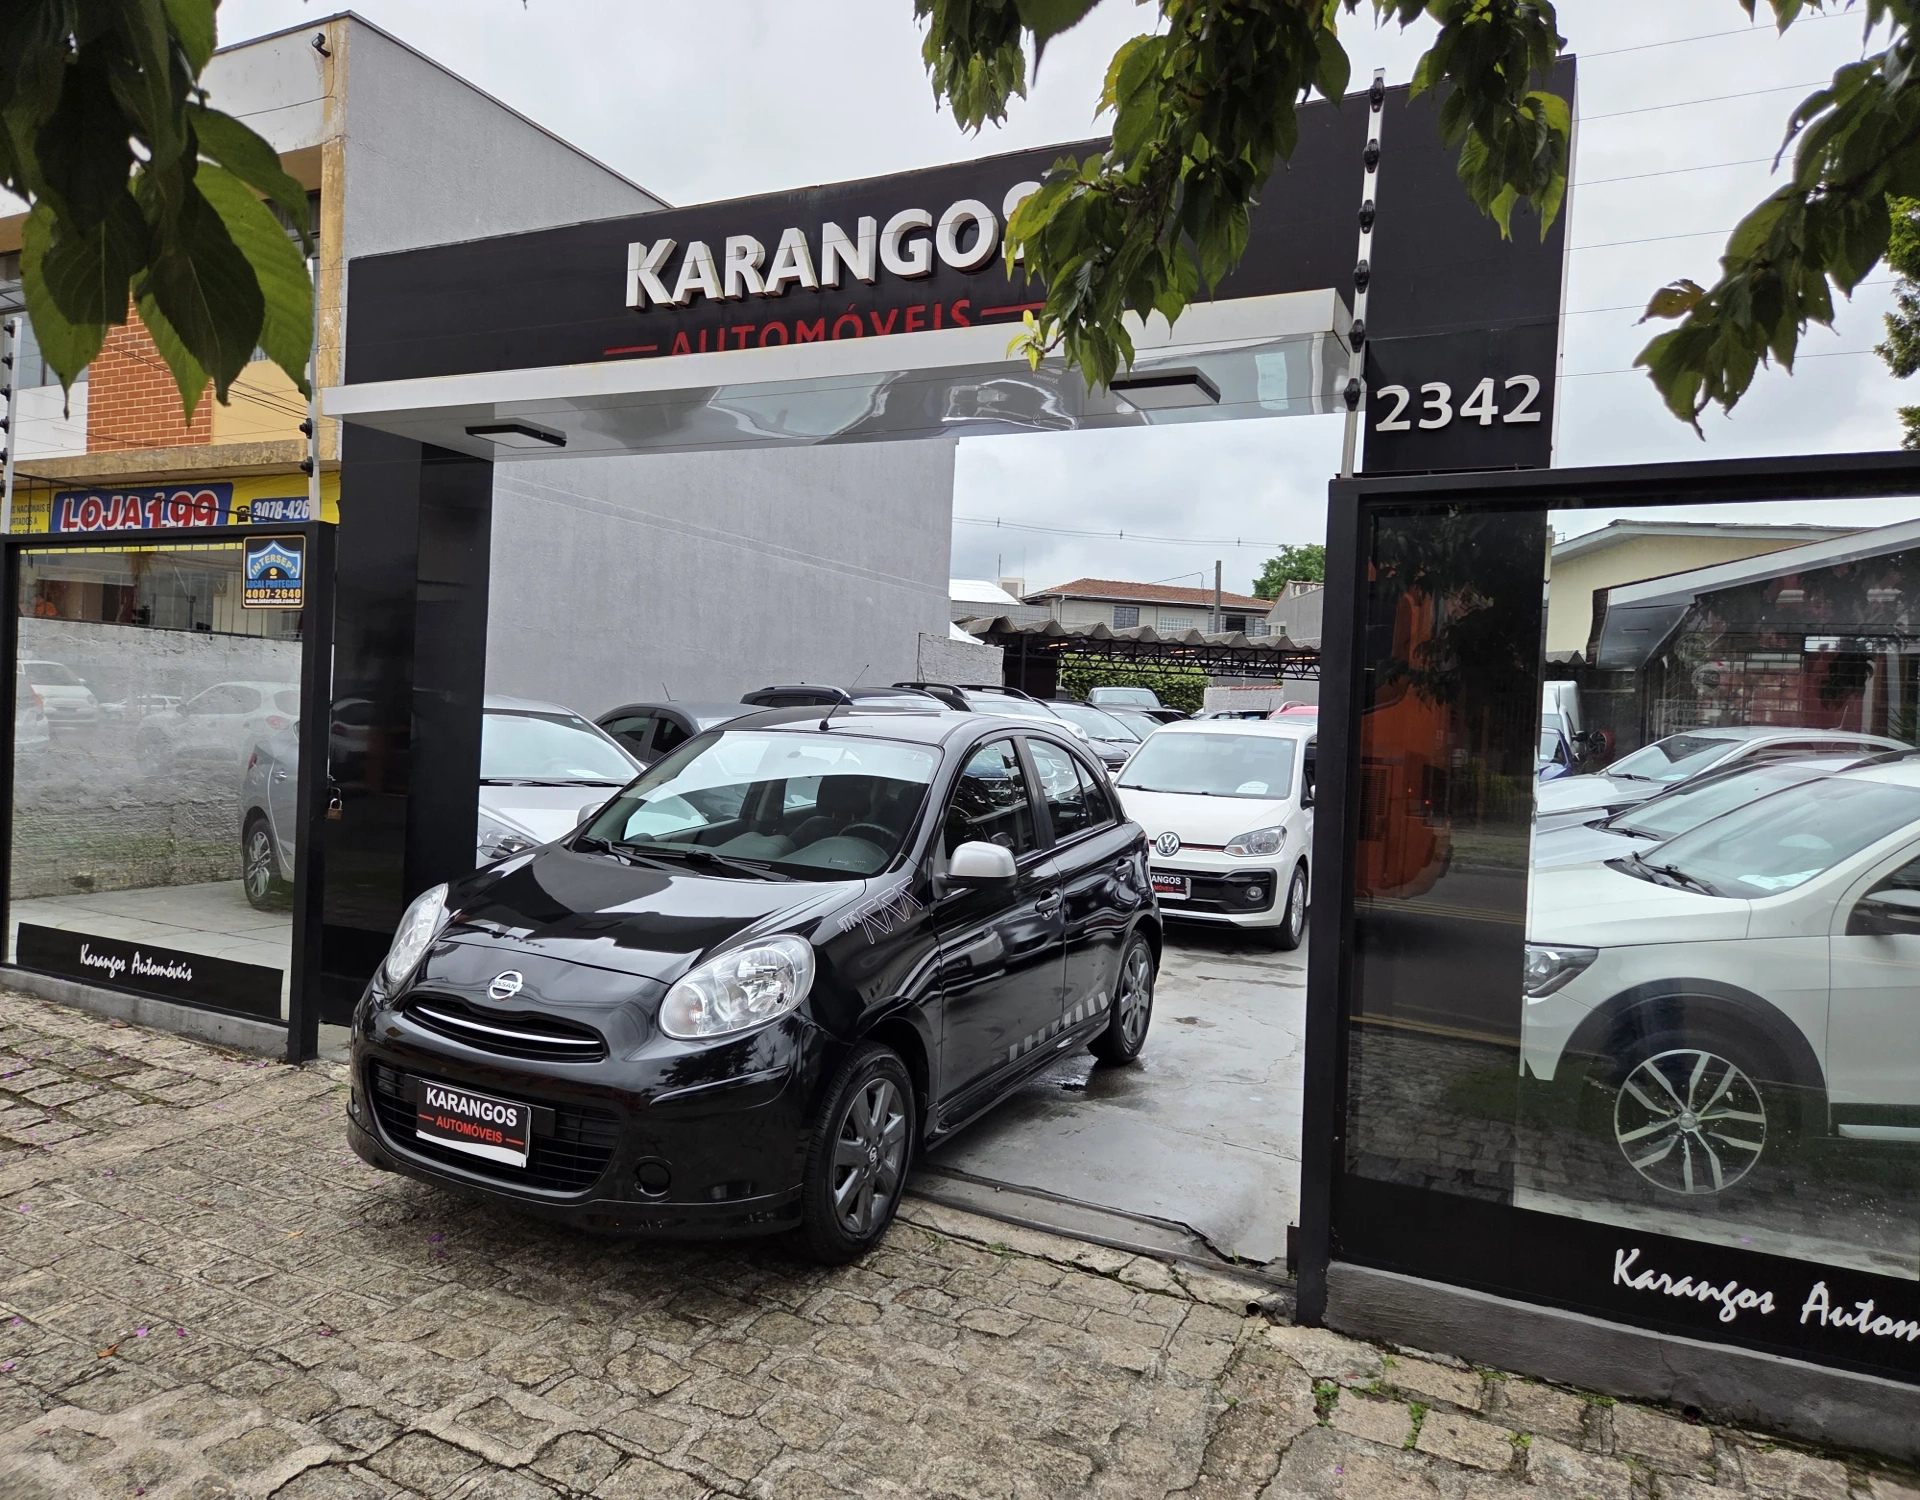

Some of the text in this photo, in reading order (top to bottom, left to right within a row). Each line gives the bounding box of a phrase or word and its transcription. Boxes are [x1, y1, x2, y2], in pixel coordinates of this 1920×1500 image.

[671, 299, 971, 356] AUTOMÓVEIS
[1375, 374, 1542, 432] 2342
[60, 496, 142, 532] LOJA
[253, 500, 311, 520] 3078-426
[251, 554, 297, 575] INTERSEPT
[245, 589, 301, 598] 4007-2640
[246, 580, 301, 588] LOCAL PROTEGIDO
[1150, 875, 1181, 885] ANGOS
[80, 943, 193, 982] Karangos Automóveis
[426, 1086, 518, 1127] KARANGOS
[436, 1115, 503, 1143] AUTOMÓVEIS
[1613, 1248, 1776, 1323] Karangos
